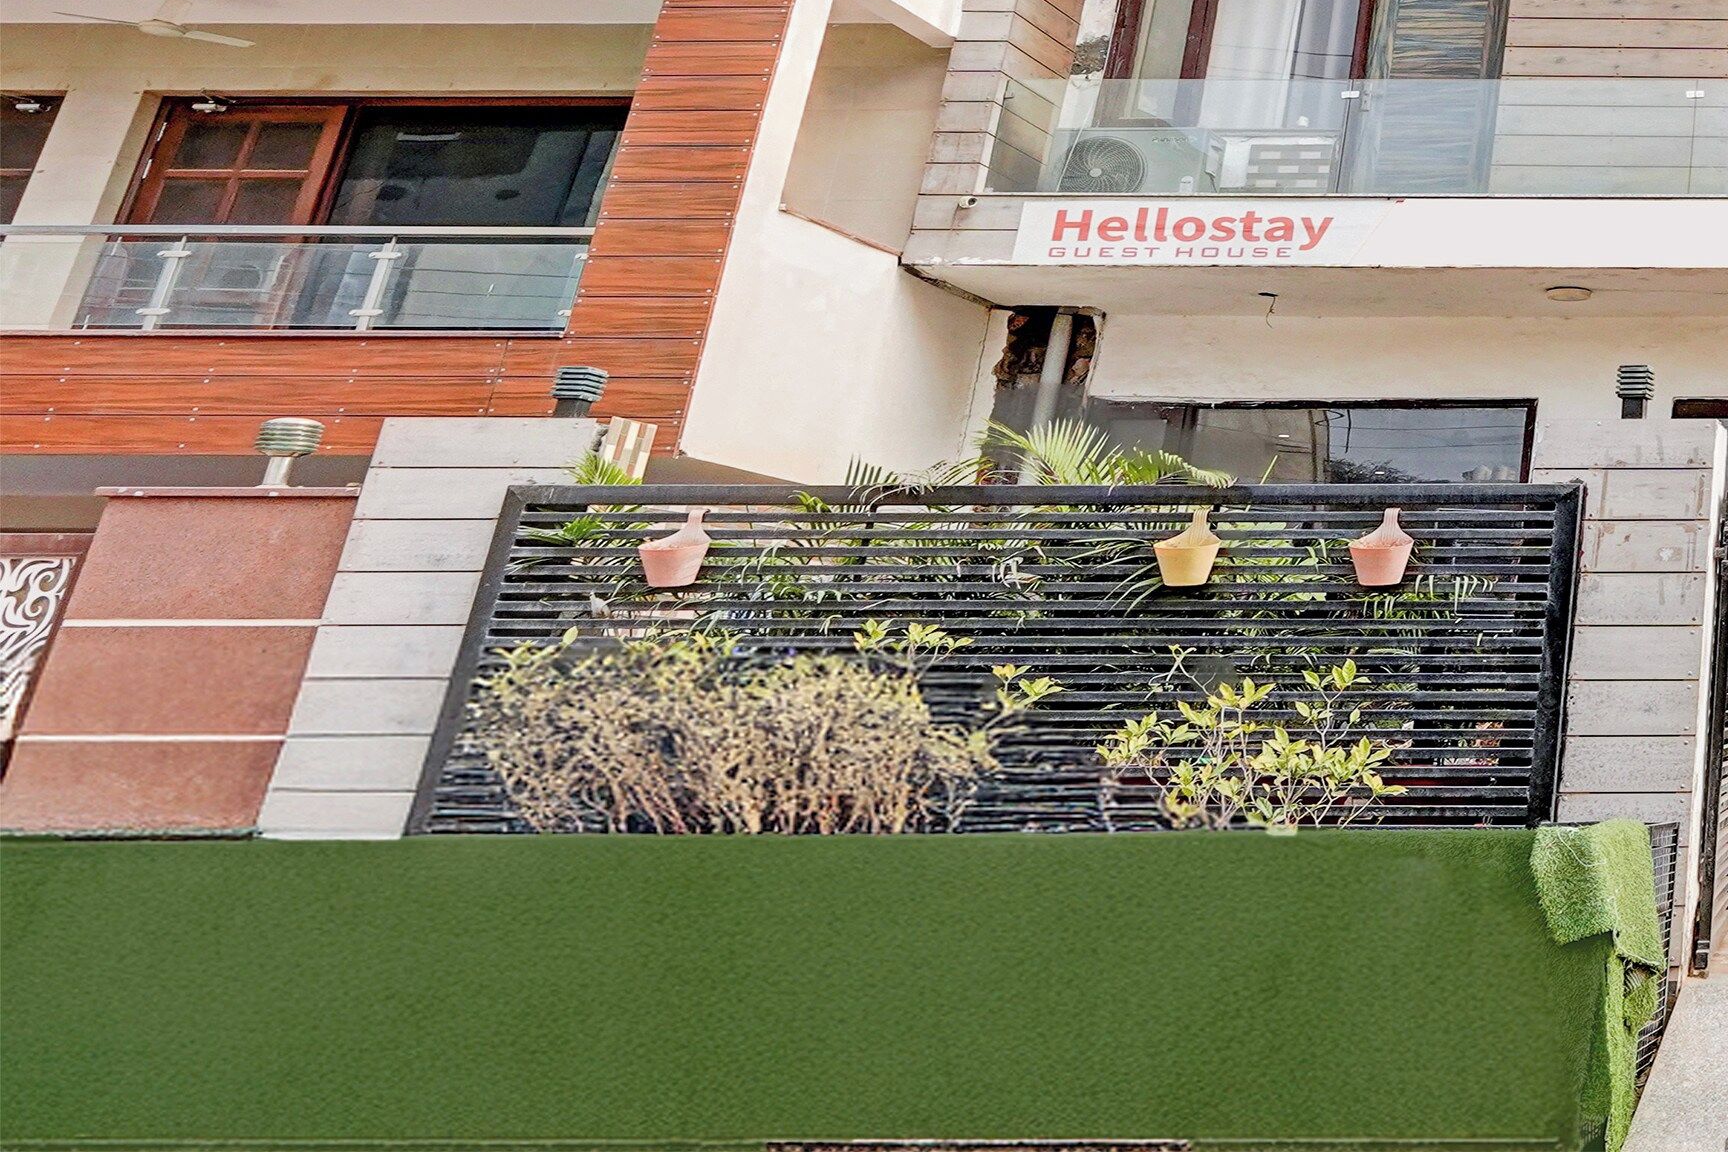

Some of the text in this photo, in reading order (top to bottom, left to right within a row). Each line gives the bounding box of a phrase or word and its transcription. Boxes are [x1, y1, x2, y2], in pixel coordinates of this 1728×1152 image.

[1050, 207, 1335, 251] Hellostay
[1047, 246, 1293, 258] GUEST HOUSE
